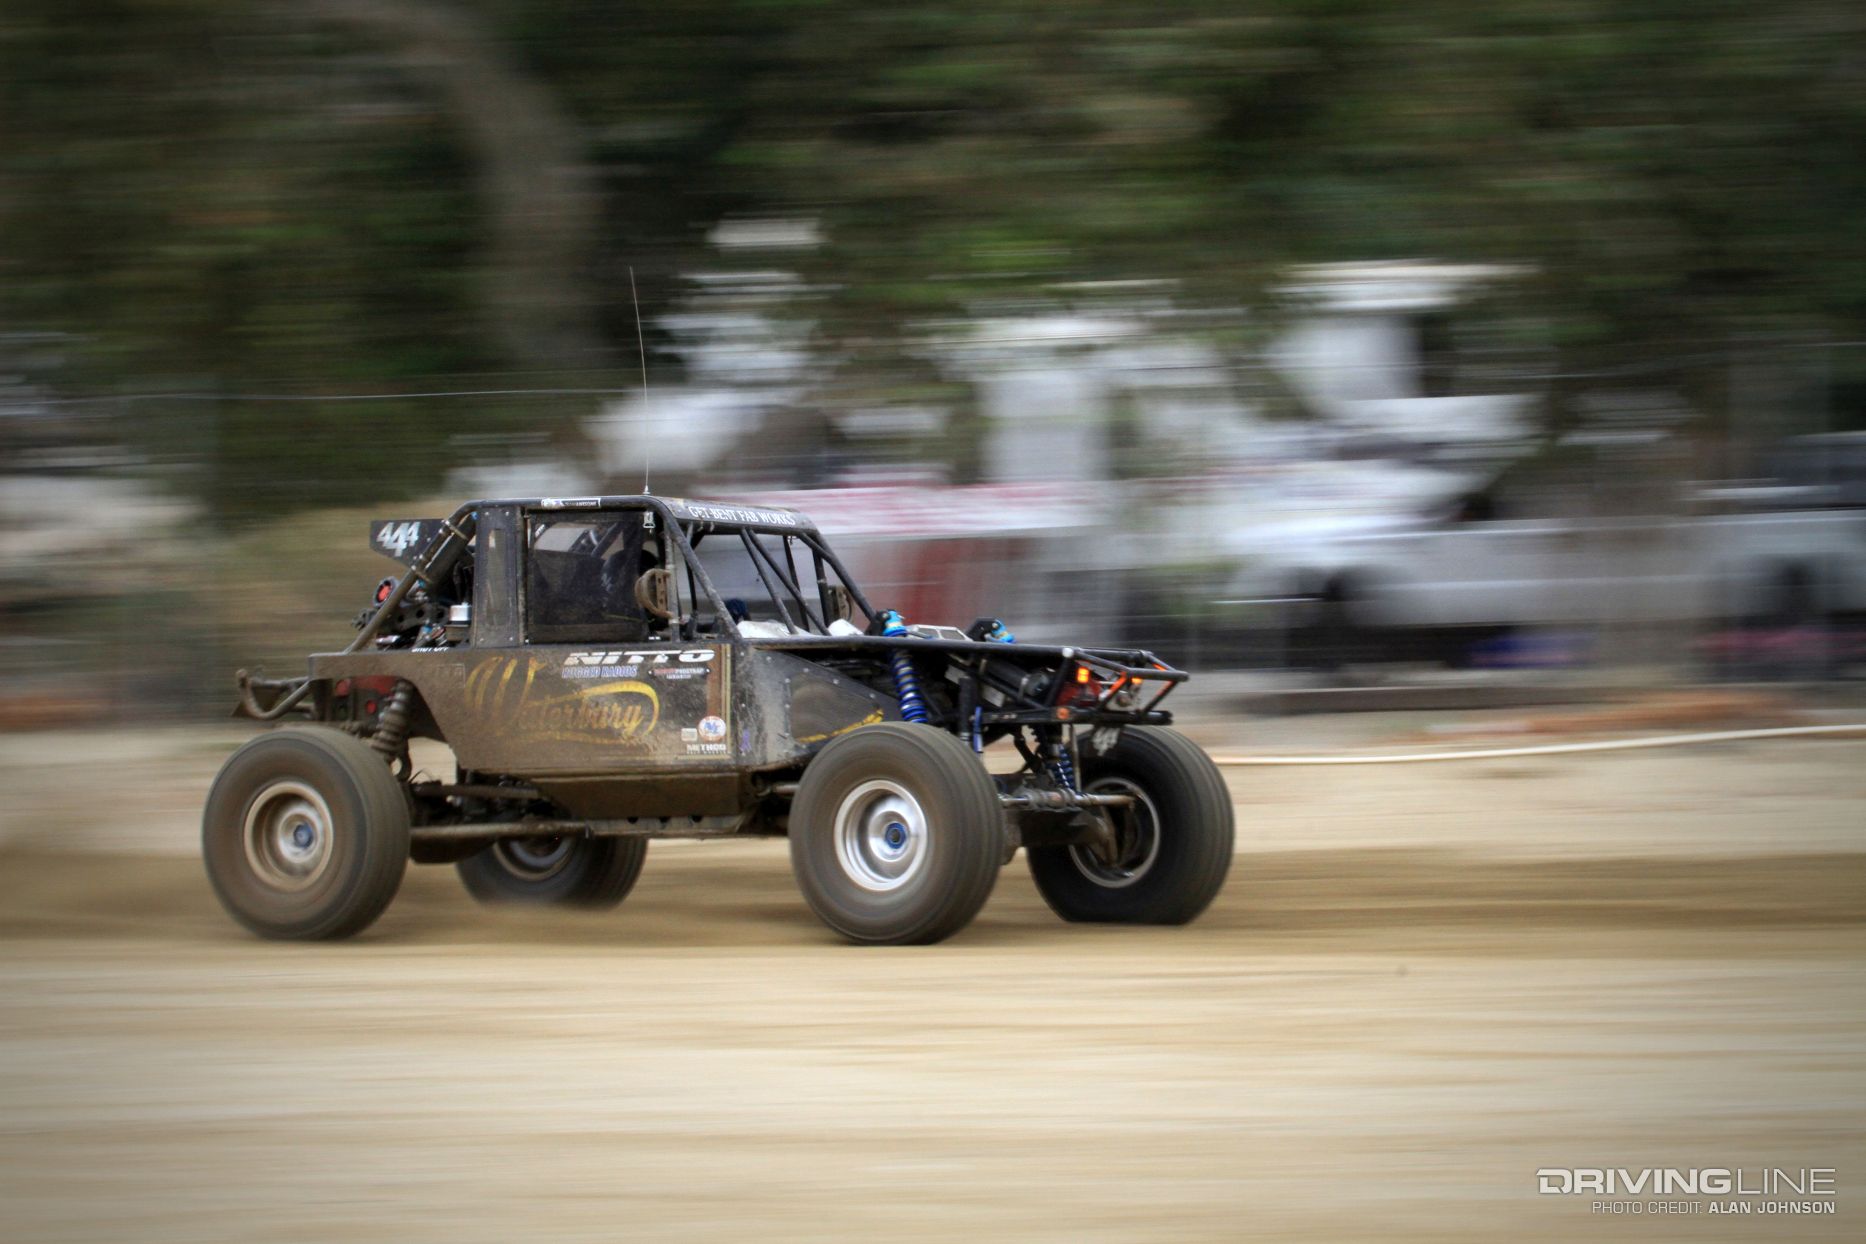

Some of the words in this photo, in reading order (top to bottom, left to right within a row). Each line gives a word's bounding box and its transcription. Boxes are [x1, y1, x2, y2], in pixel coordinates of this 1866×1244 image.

[688, 506, 738, 521] GET-BENT
[737, 510, 760, 523] FAB
[757, 512, 796, 526] WORKS
[376, 521, 421, 557] 444
[564, 649, 715, 665] NITTO
[601, 665, 638, 678] RADIOS
